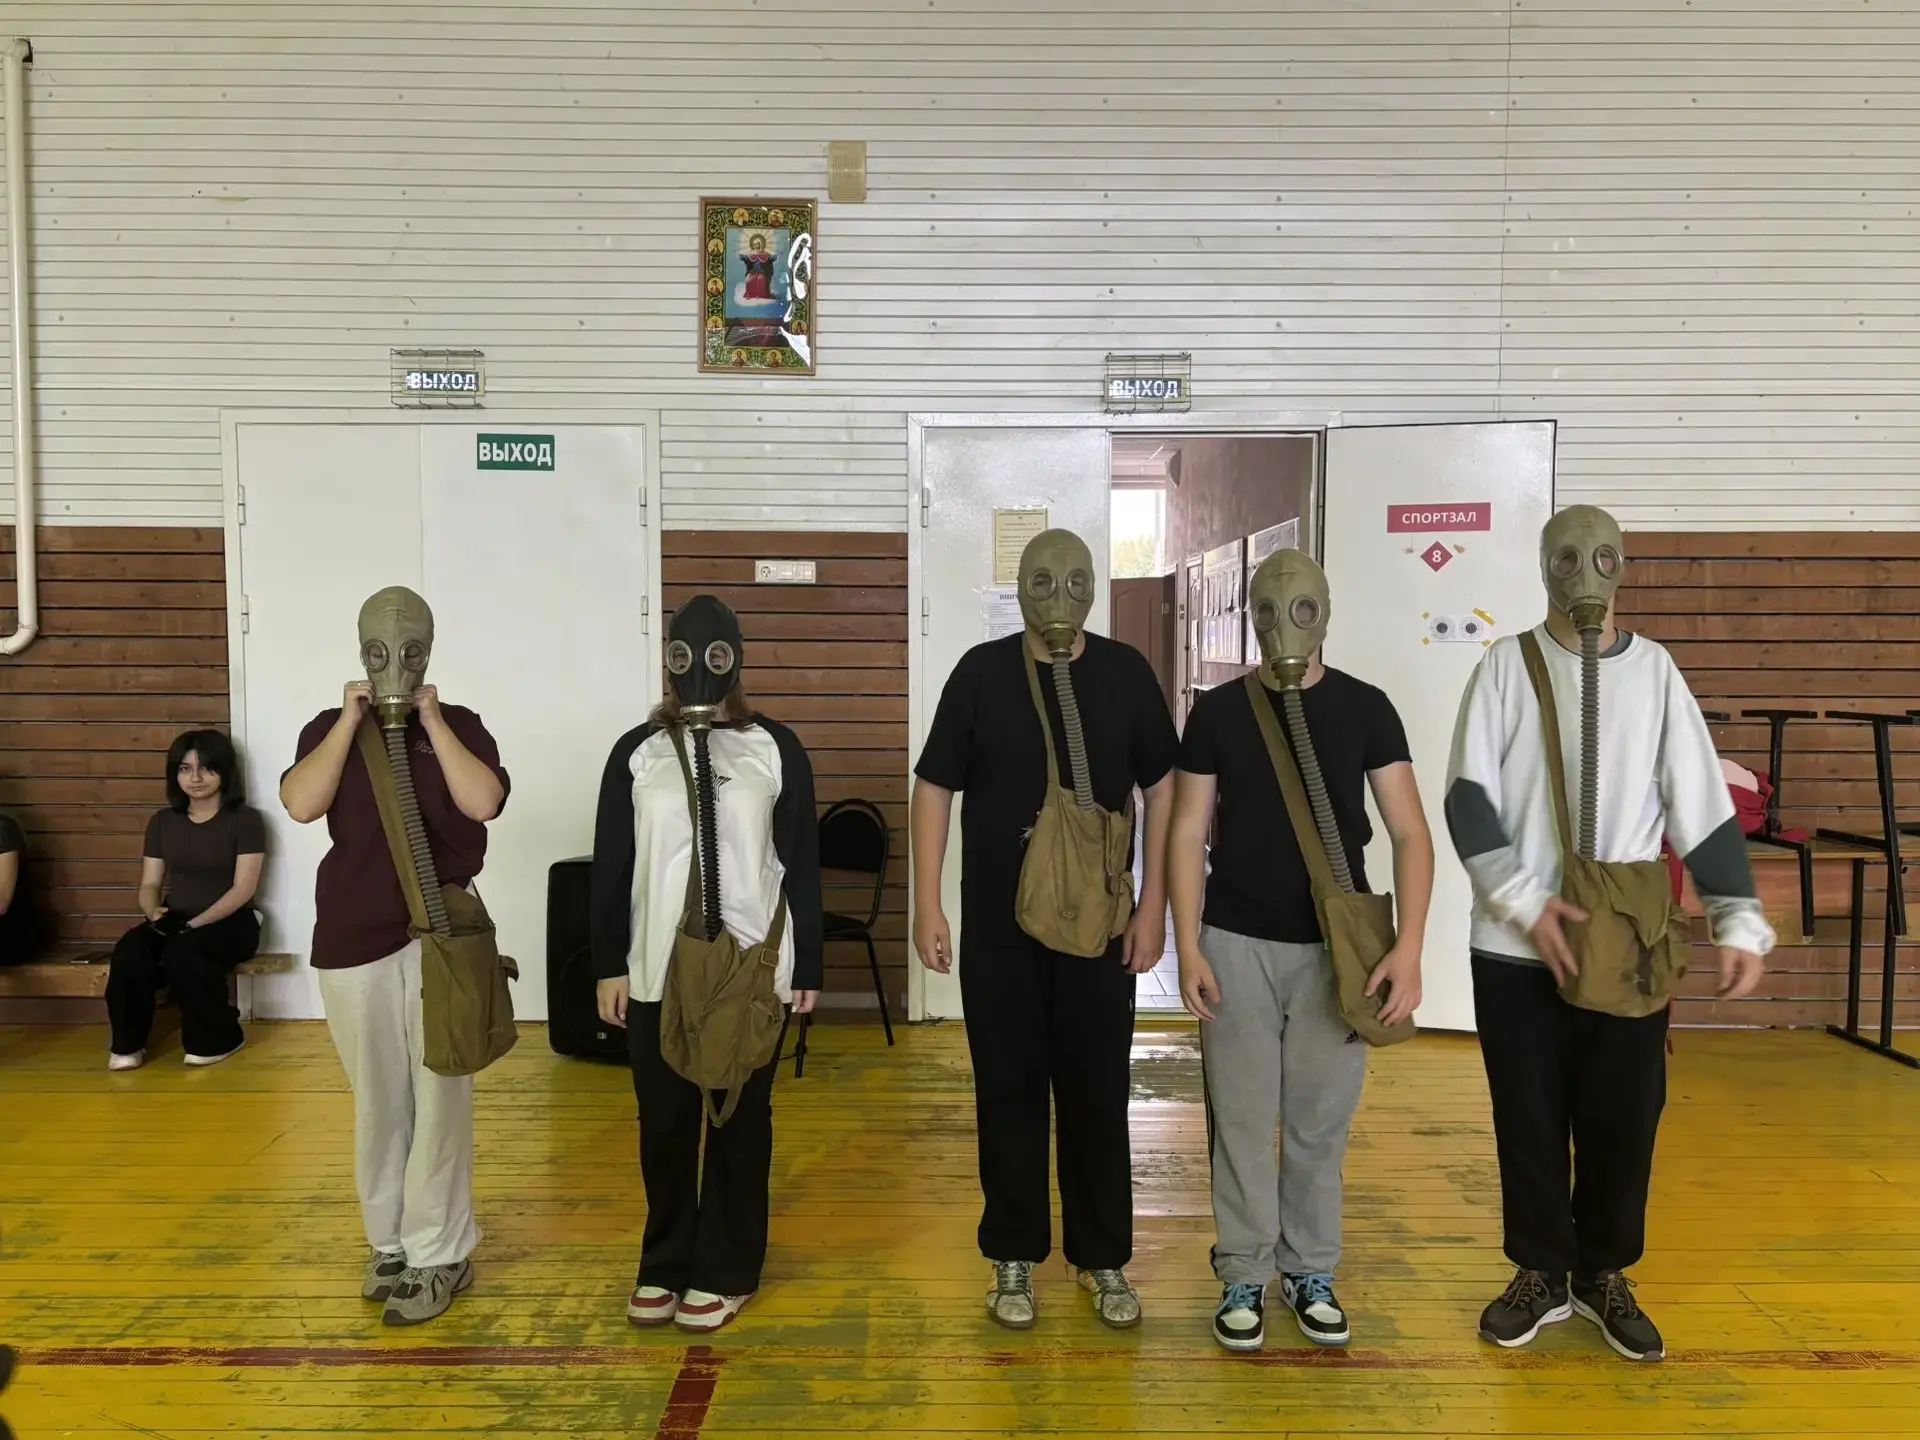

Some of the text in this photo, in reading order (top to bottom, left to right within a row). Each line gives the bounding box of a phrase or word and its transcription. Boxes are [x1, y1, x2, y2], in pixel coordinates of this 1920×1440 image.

[410, 372, 477, 391] ВЫХОД
[1111, 379, 1178, 399] ВЫХОД
[479, 442, 552, 466] ВЫХОД
[1401, 511, 1477, 524] СПОРТЗАЛ
[1432, 549, 1442, 563] 8
